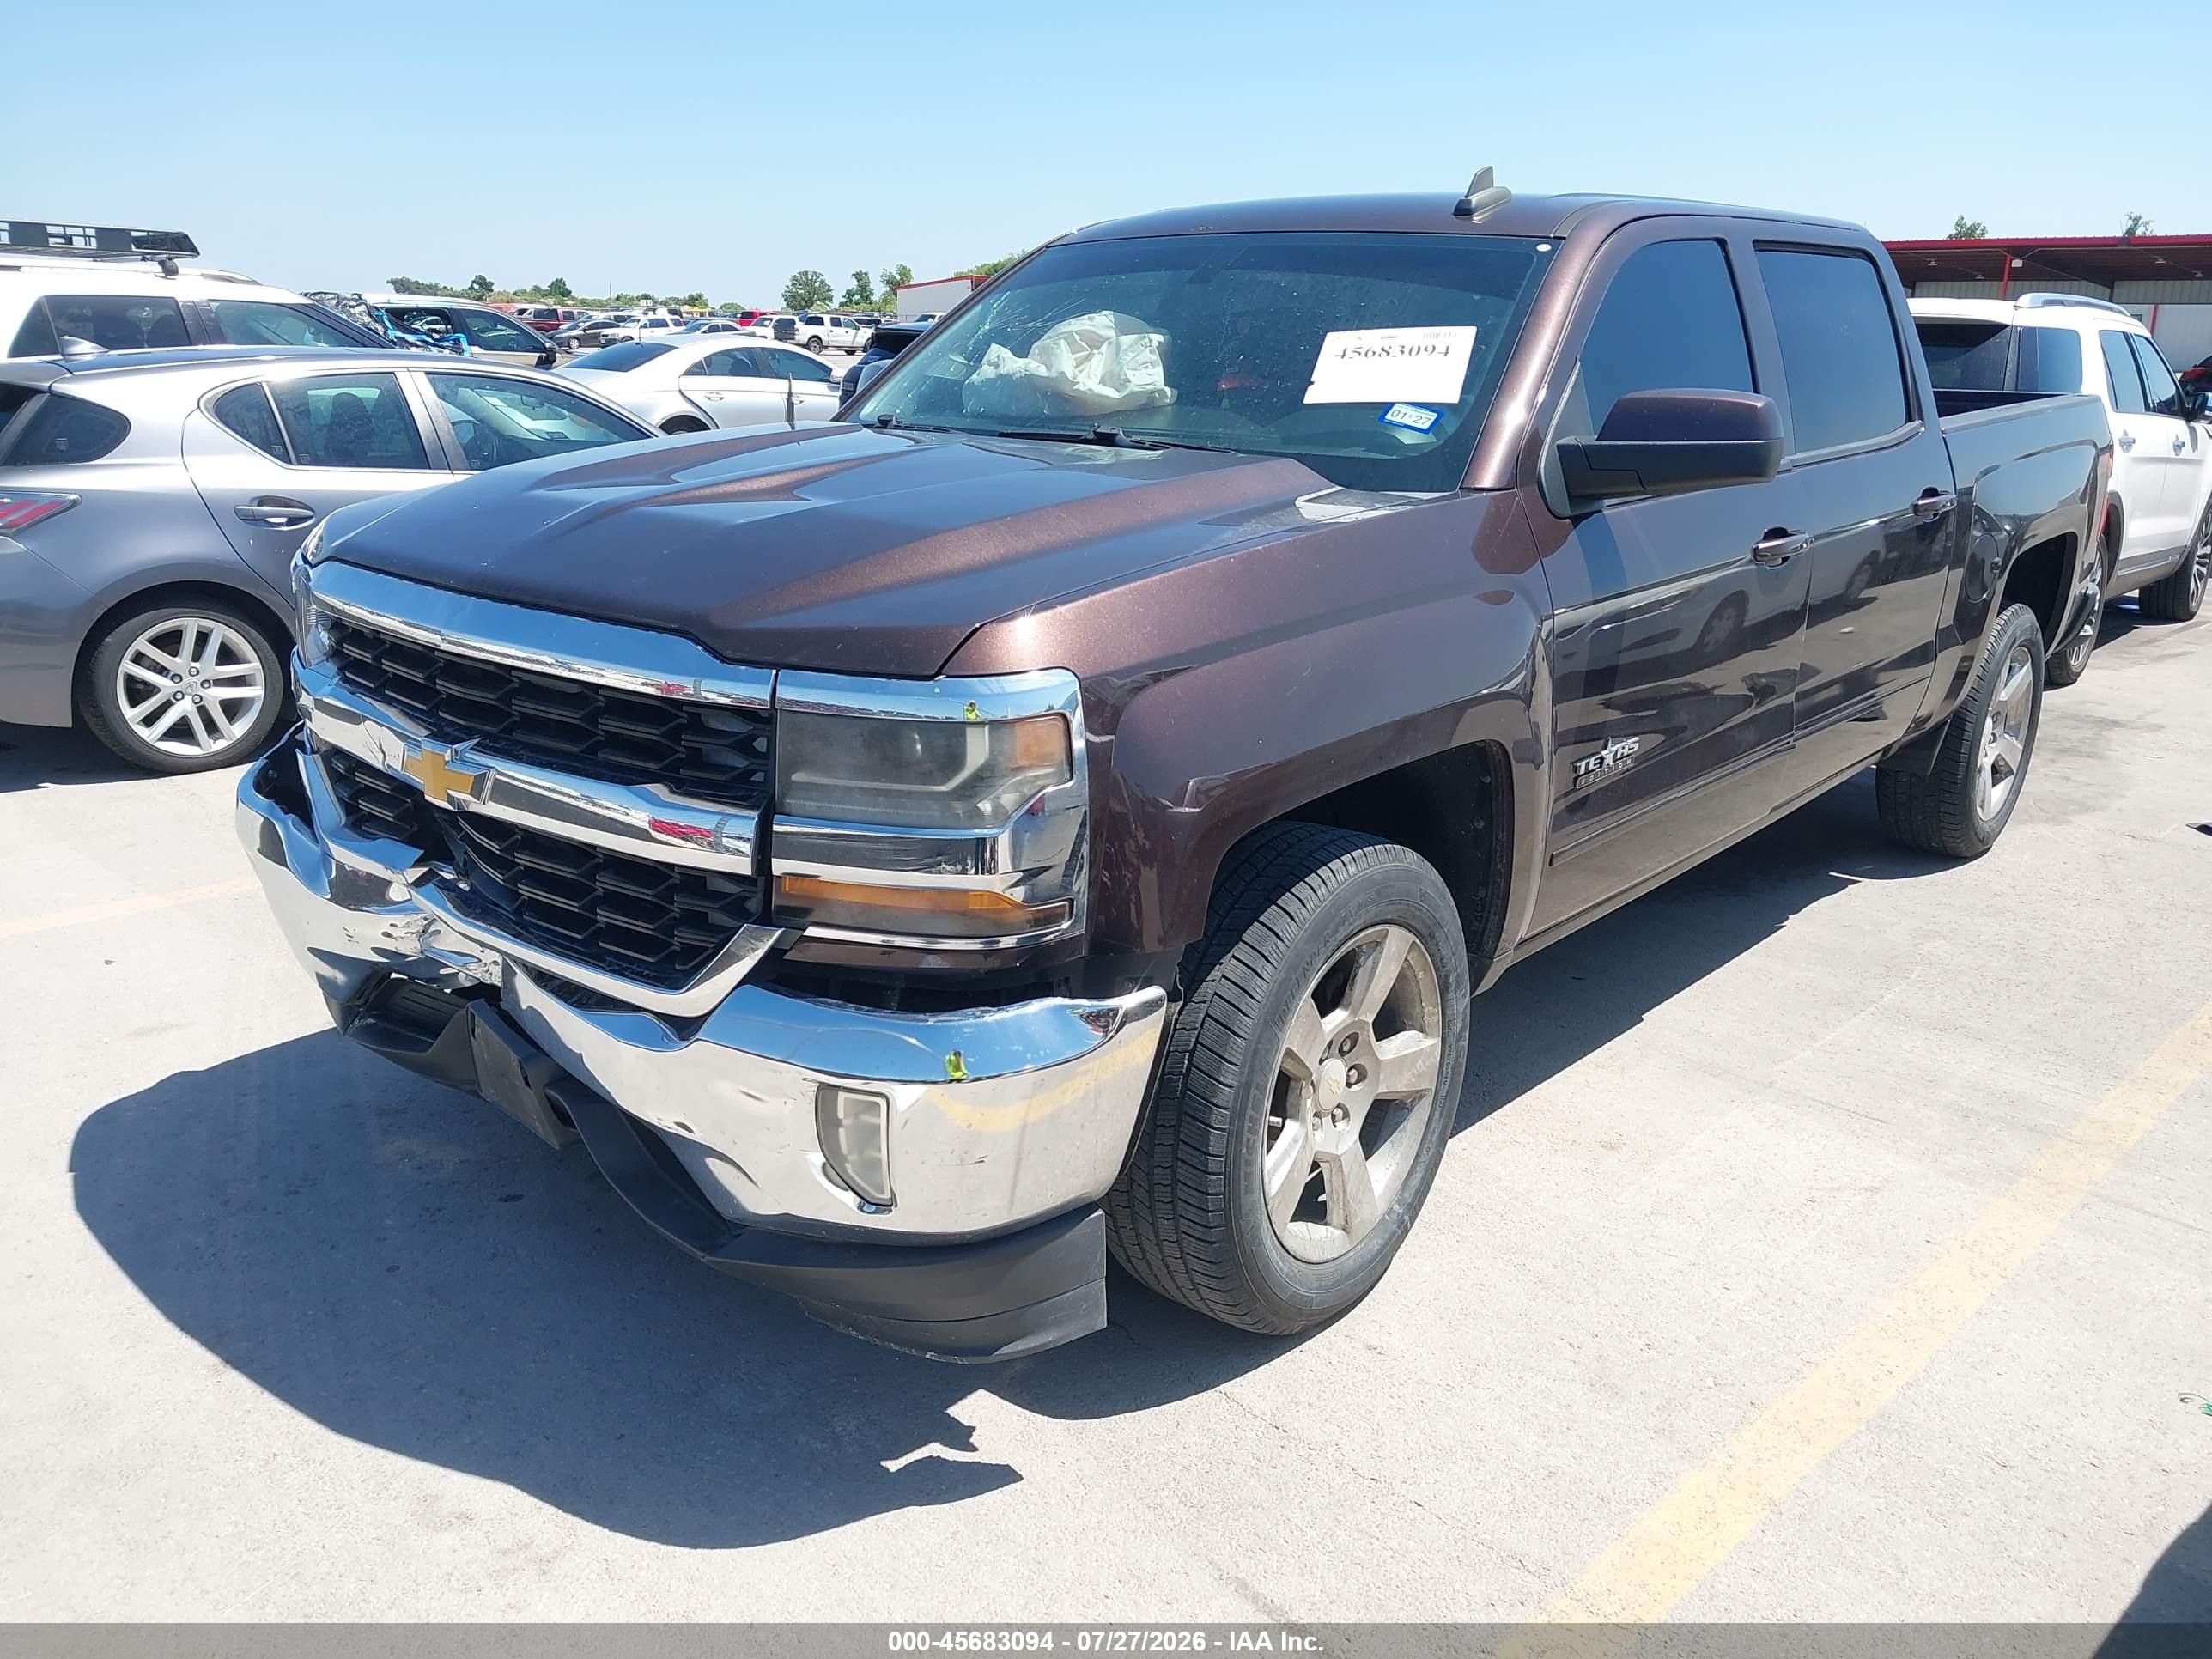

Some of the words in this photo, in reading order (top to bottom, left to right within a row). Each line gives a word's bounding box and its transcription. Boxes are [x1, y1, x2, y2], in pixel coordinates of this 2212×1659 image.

[1334, 343, 1450, 360] 45683094
[1573, 736, 1641, 775] TEXAS
[1581, 757, 1632, 785] EDITION
